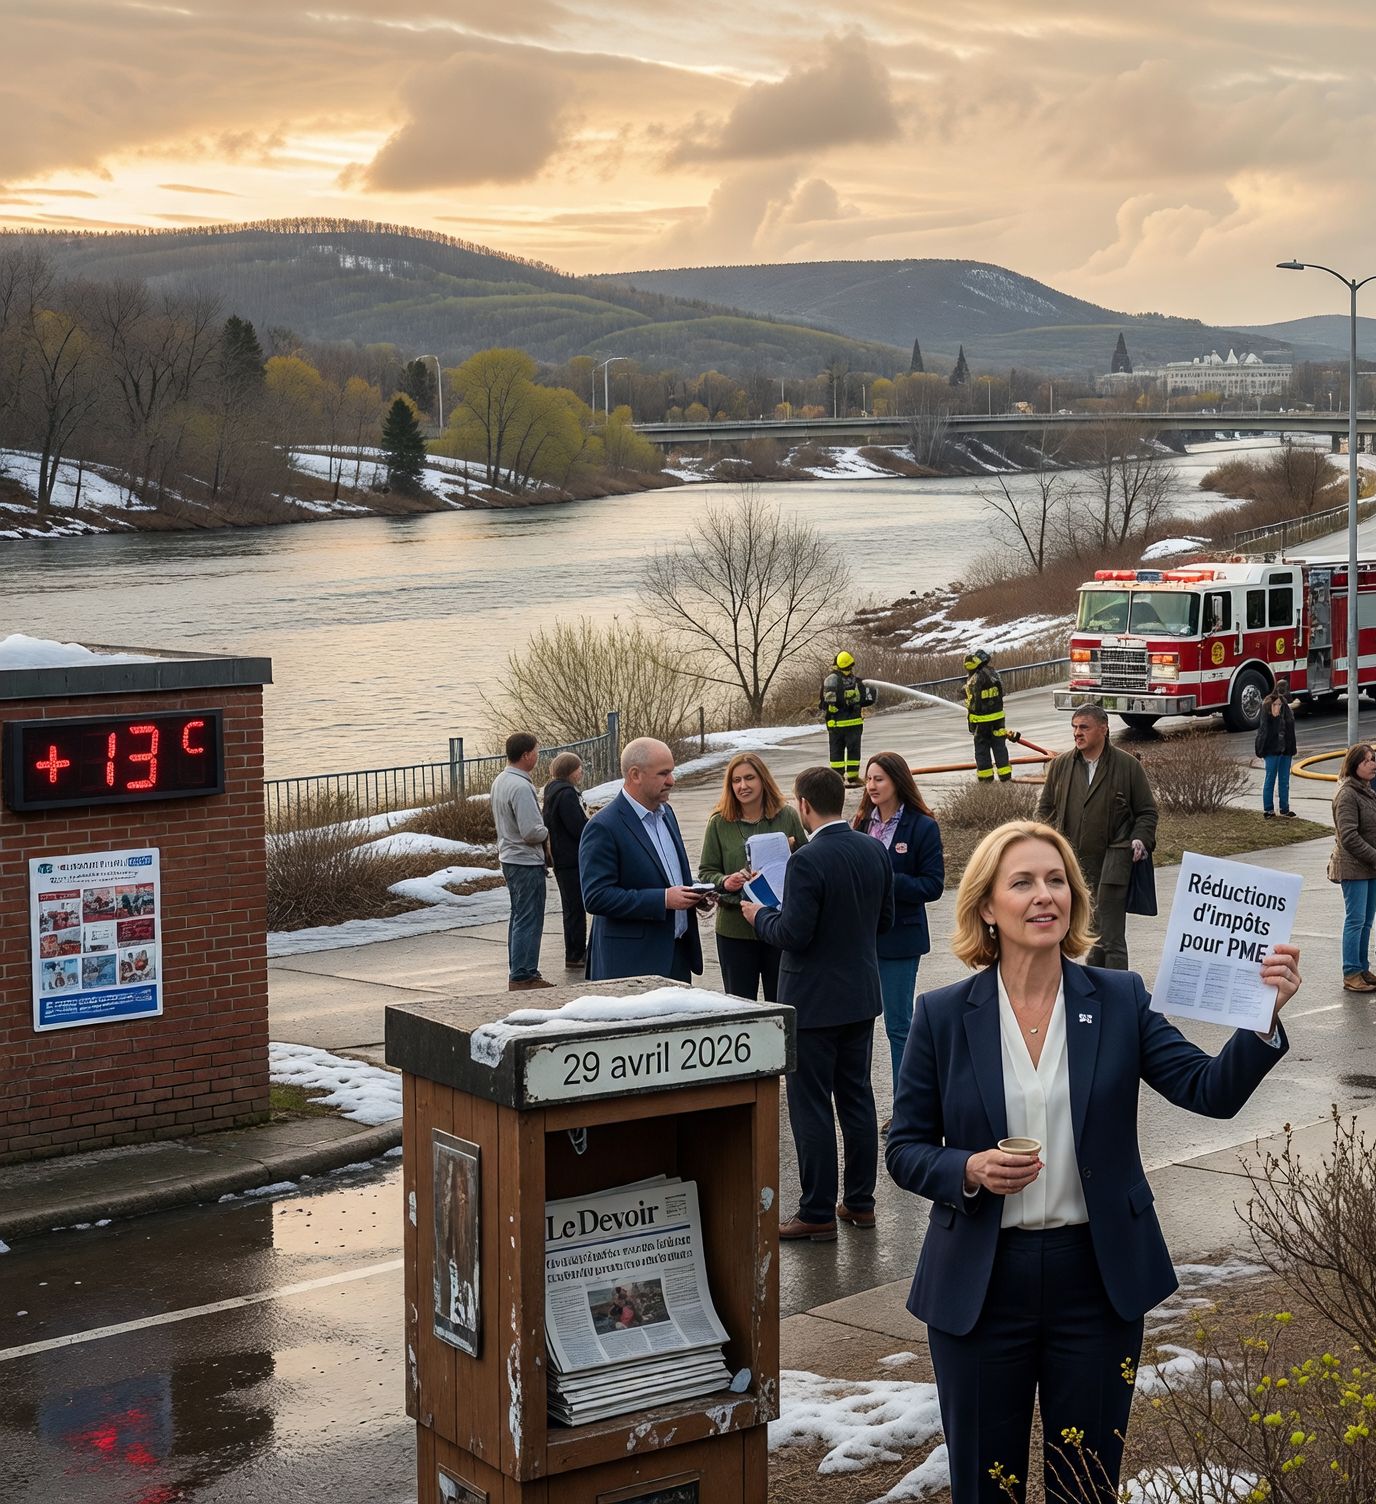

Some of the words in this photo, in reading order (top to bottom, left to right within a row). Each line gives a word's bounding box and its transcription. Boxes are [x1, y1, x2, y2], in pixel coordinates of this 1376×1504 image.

[1187, 872, 1287, 912] Réductions
[1192, 902, 1271, 936] d'impôts
[1179, 932, 1224, 954] pour
[1226, 937, 1269, 964] PME
[563, 1051, 600, 1086] 29
[610, 1040, 670, 1080] avril
[680, 1032, 752, 1071] 2026
[546, 1214, 576, 1241] Le
[576, 1200, 660, 1237] Devoir
